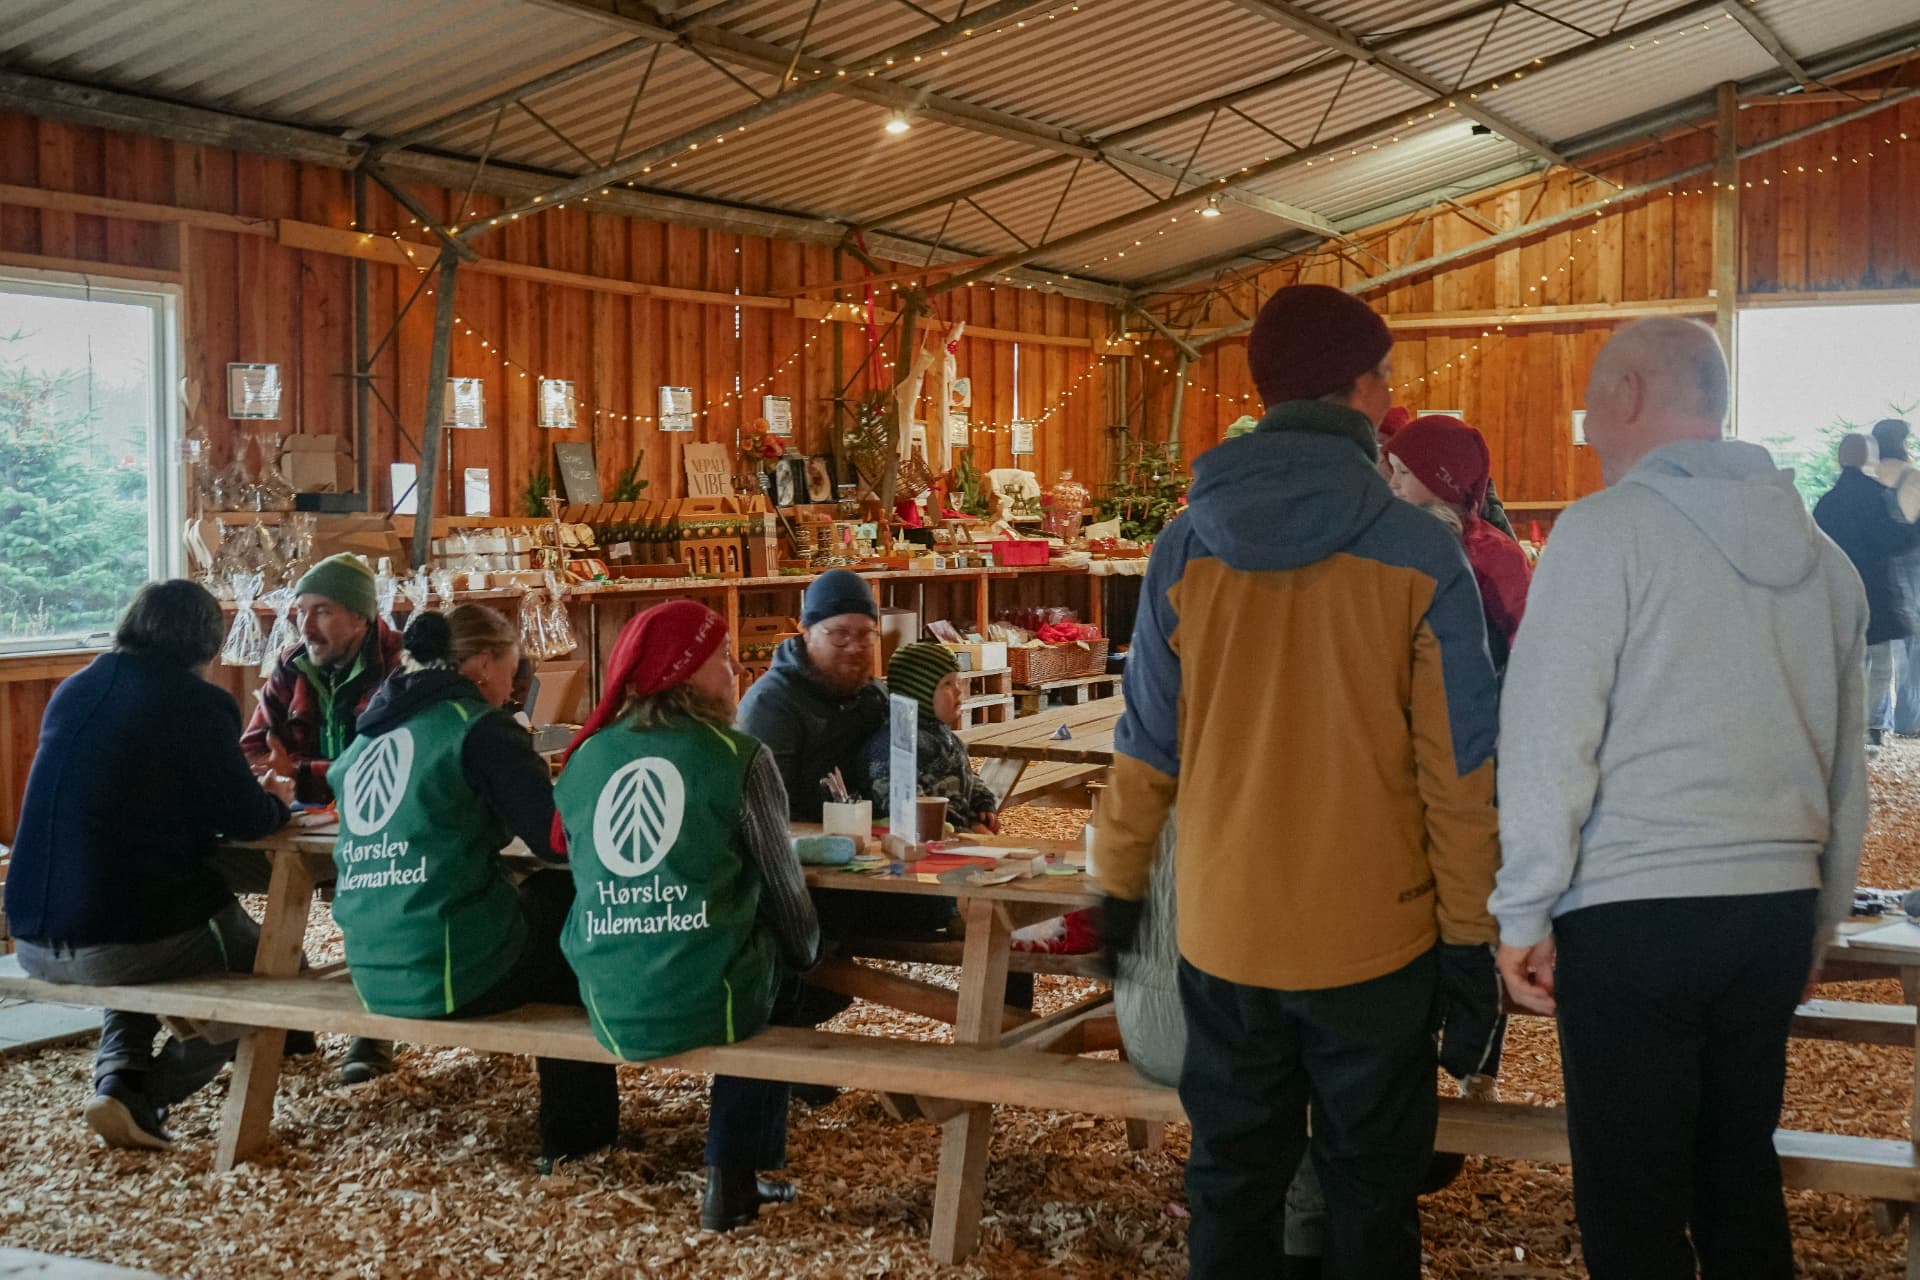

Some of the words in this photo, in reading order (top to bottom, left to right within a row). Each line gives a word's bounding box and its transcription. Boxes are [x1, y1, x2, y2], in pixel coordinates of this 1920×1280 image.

[693, 473, 729, 495] VIBE
[342, 832, 409, 864] Hørslev
[596, 874, 688, 905] Hørslev
[585, 899, 711, 943] Julemarked
